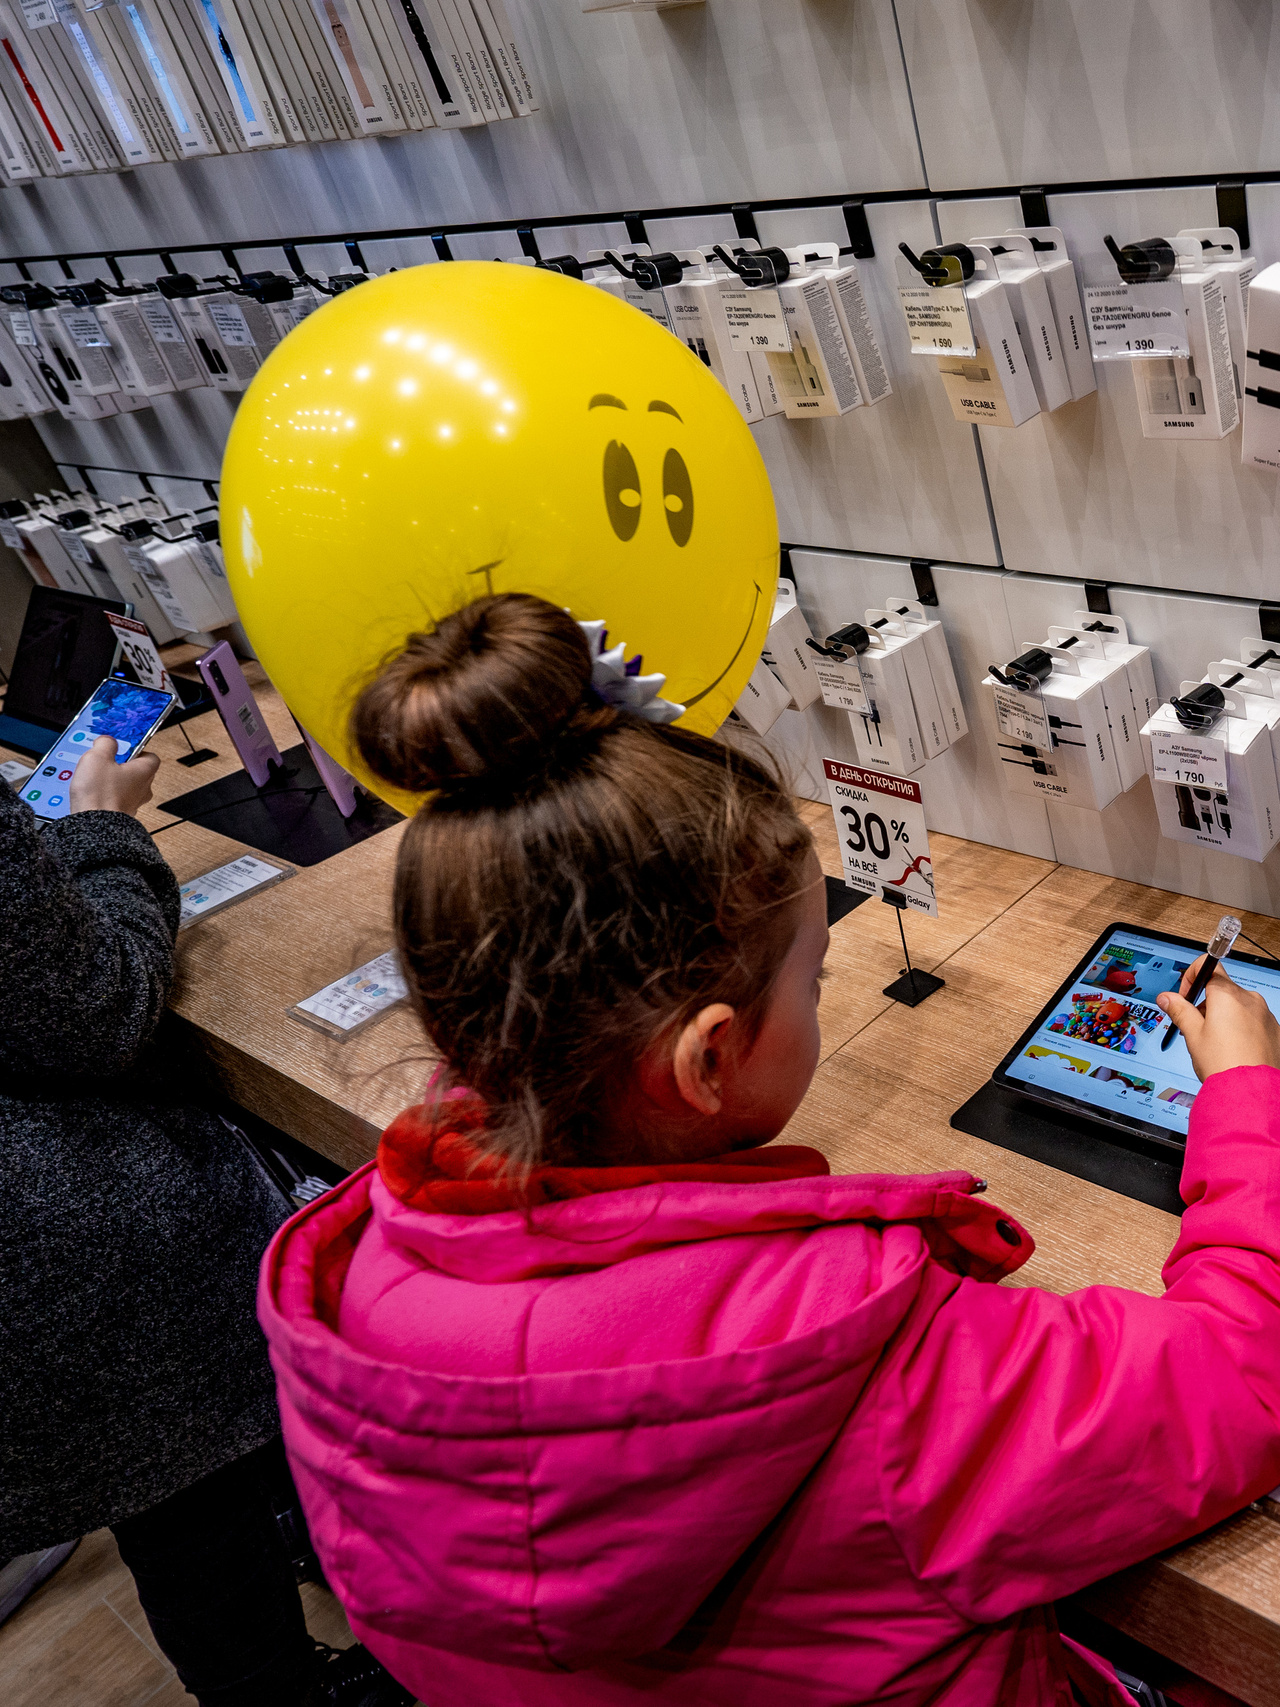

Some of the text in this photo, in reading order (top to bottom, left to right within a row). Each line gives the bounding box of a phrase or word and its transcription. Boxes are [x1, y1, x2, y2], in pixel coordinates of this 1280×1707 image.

[451, 55, 462, 73] Band
[466, 52, 476, 70] Band
[459, 74, 470, 92] Sport
[474, 71, 484, 90] Sport
[756, 336, 768, 344] 390
[1069, 315, 1079, 350] SAMSUNG
[933, 338, 952, 348] 1 590
[1041, 326, 1052, 361] SAMSUNG
[1126, 340, 1154, 350] 1 390
[1002, 339, 1016, 375] SAMSUNG
[960, 399, 996, 410] USB CABLE
[1121, 715, 1130, 742] SAMSUNG
[1096, 733, 1105, 761] SAMSUNG
[831, 765, 914, 796] В ДЕНЬ ОТКРЫТИЯ
[1175, 770, 1204, 783] 1 790
[836, 786, 869, 802] СКИДКА
[1033, 780, 1067, 794] USB CABLE
[1197, 835, 1222, 845] SAMSUNG
[849, 857, 878, 874] НА ВСЁ
[851, 875, 876, 888] SAMSUNG
[908, 895, 930, 910] Galaxy
